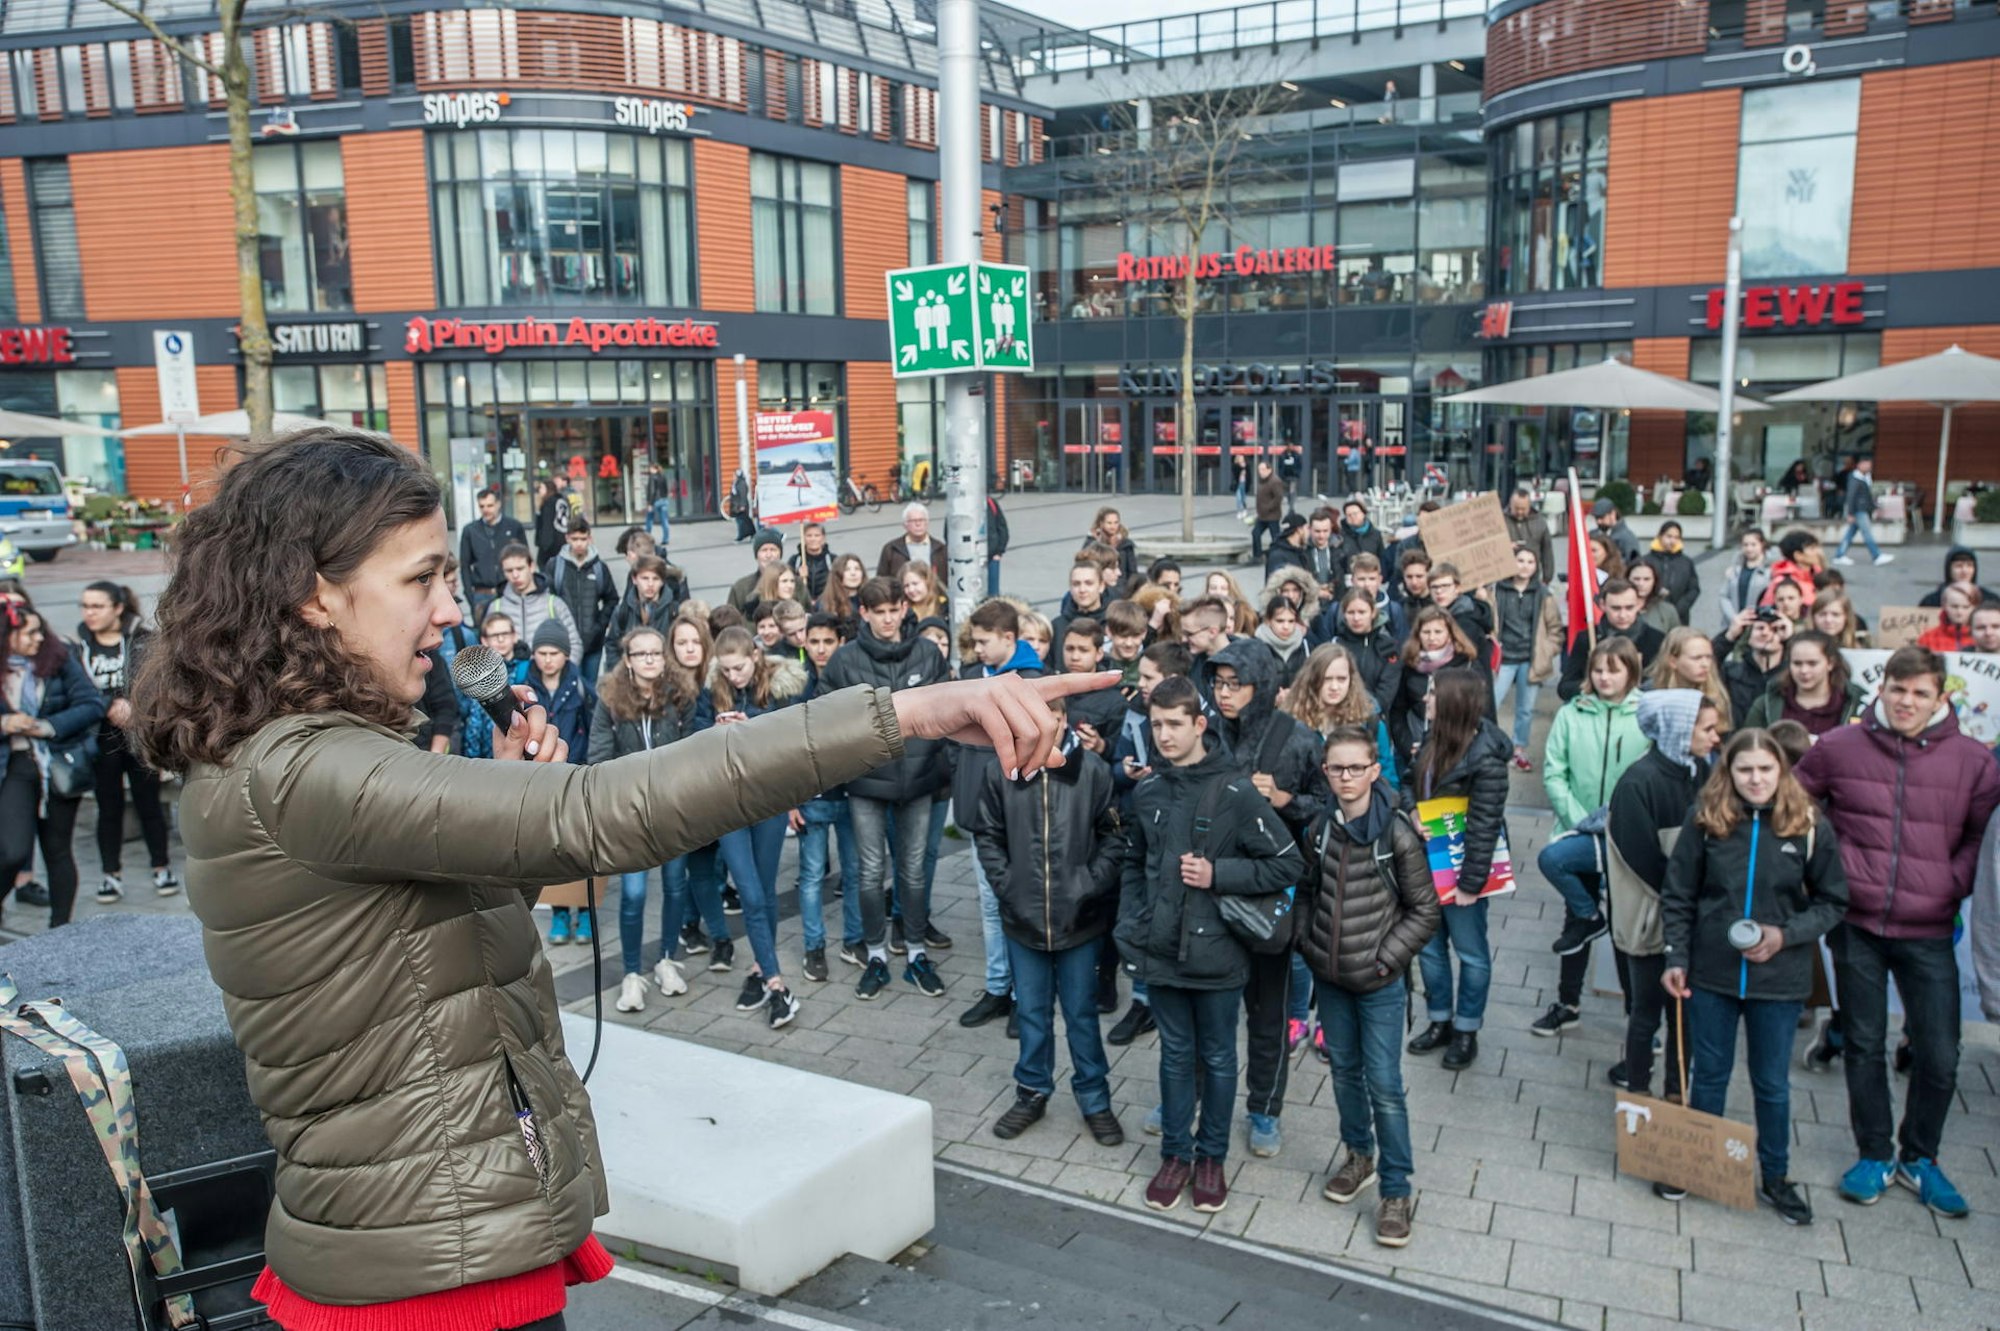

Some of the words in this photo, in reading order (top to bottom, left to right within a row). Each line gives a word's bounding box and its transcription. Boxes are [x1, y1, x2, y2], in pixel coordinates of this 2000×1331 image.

[423, 92, 501, 128] snipes
[615, 96, 688, 134] snipes
[0, 326, 77, 364] EWE
[274, 323, 361, 353] SATURN
[434, 317, 558, 352] Pinguin
[565, 317, 718, 352] Apotheke
[1119, 359, 1337, 396] KINOPOLIS
